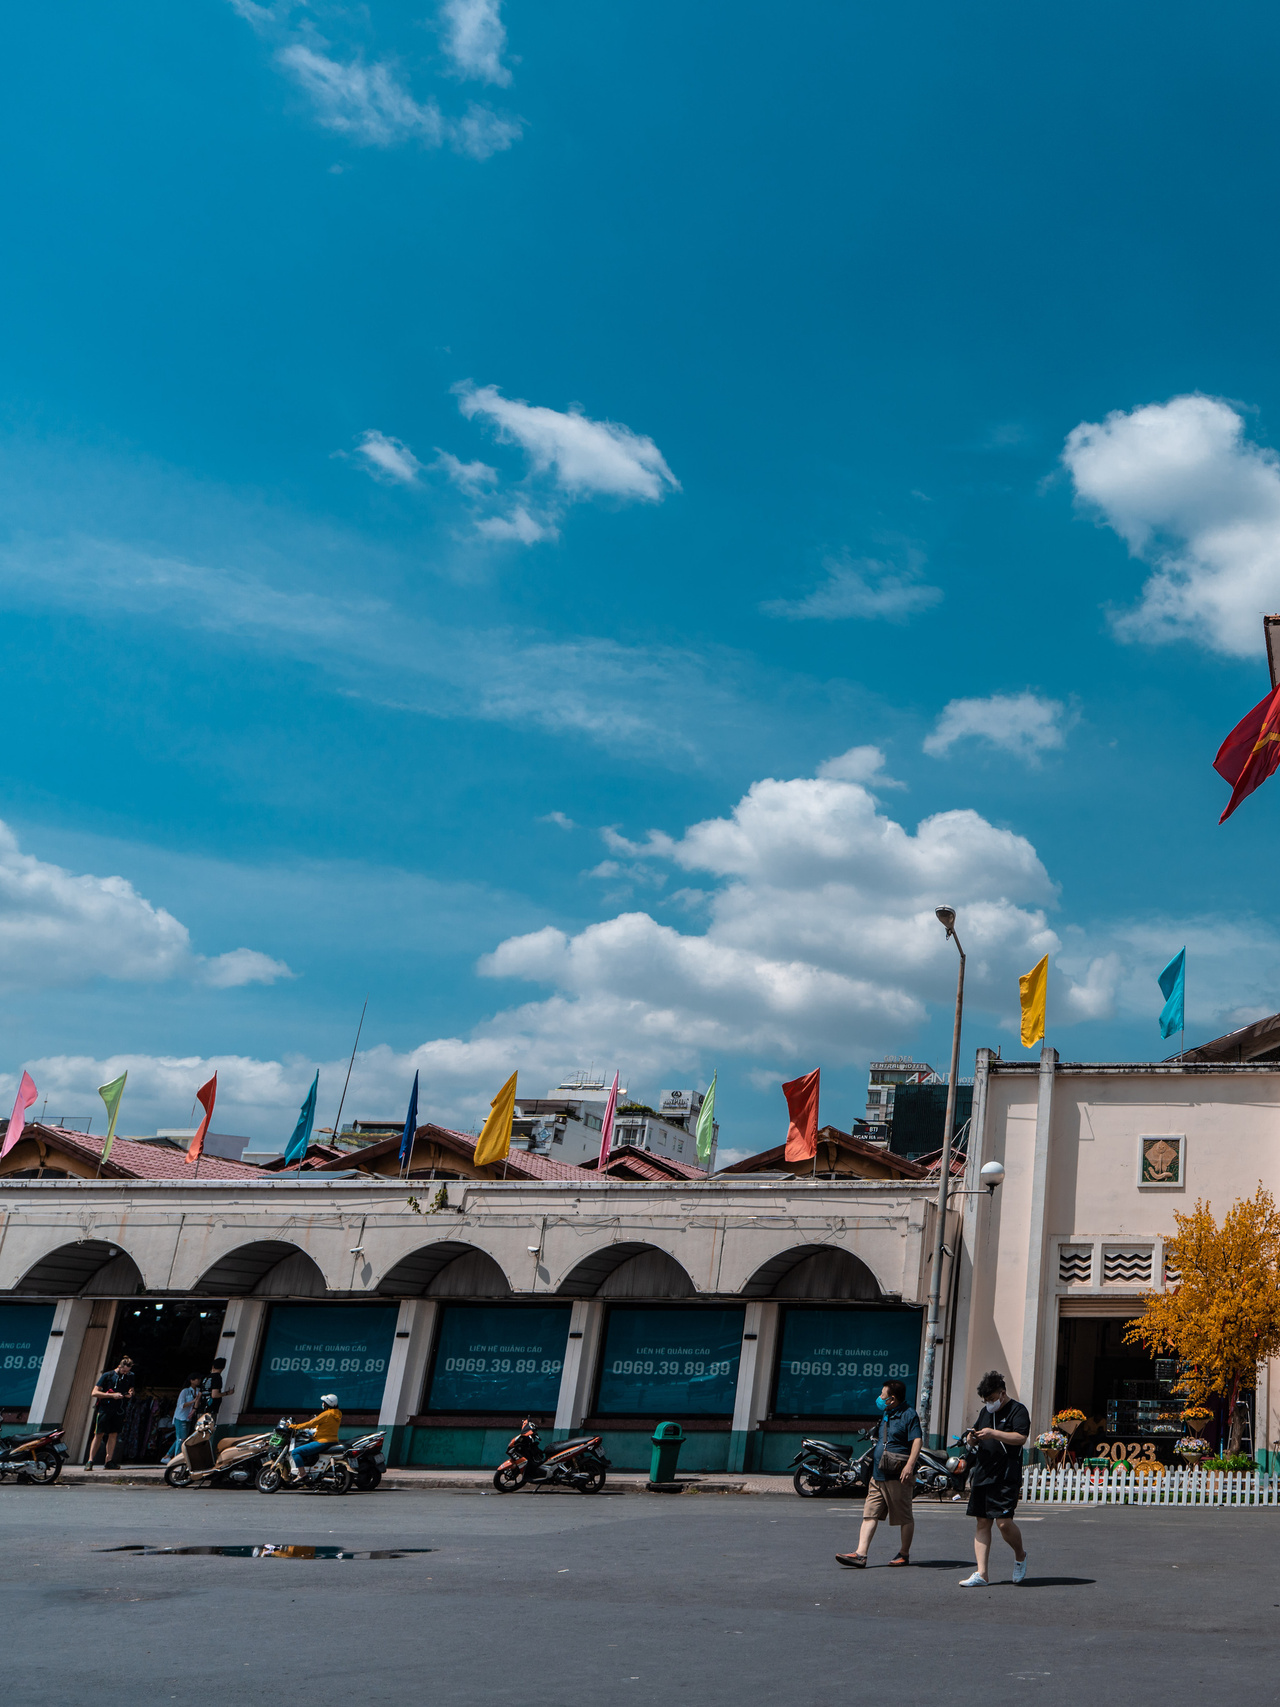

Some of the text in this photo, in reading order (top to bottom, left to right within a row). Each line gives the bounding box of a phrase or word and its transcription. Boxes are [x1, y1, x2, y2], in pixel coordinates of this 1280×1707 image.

[16, 1341, 31, 1350] CÁO
[270, 1357, 385, 1372] 0969.39.89.89
[445, 1358, 561, 1373] 0969.39.89.89
[612, 1361, 730, 1375] 0969.39.89.89
[790, 1361, 909, 1377] 0969.39.89.89
[1096, 1441, 1157, 1463] 2023
